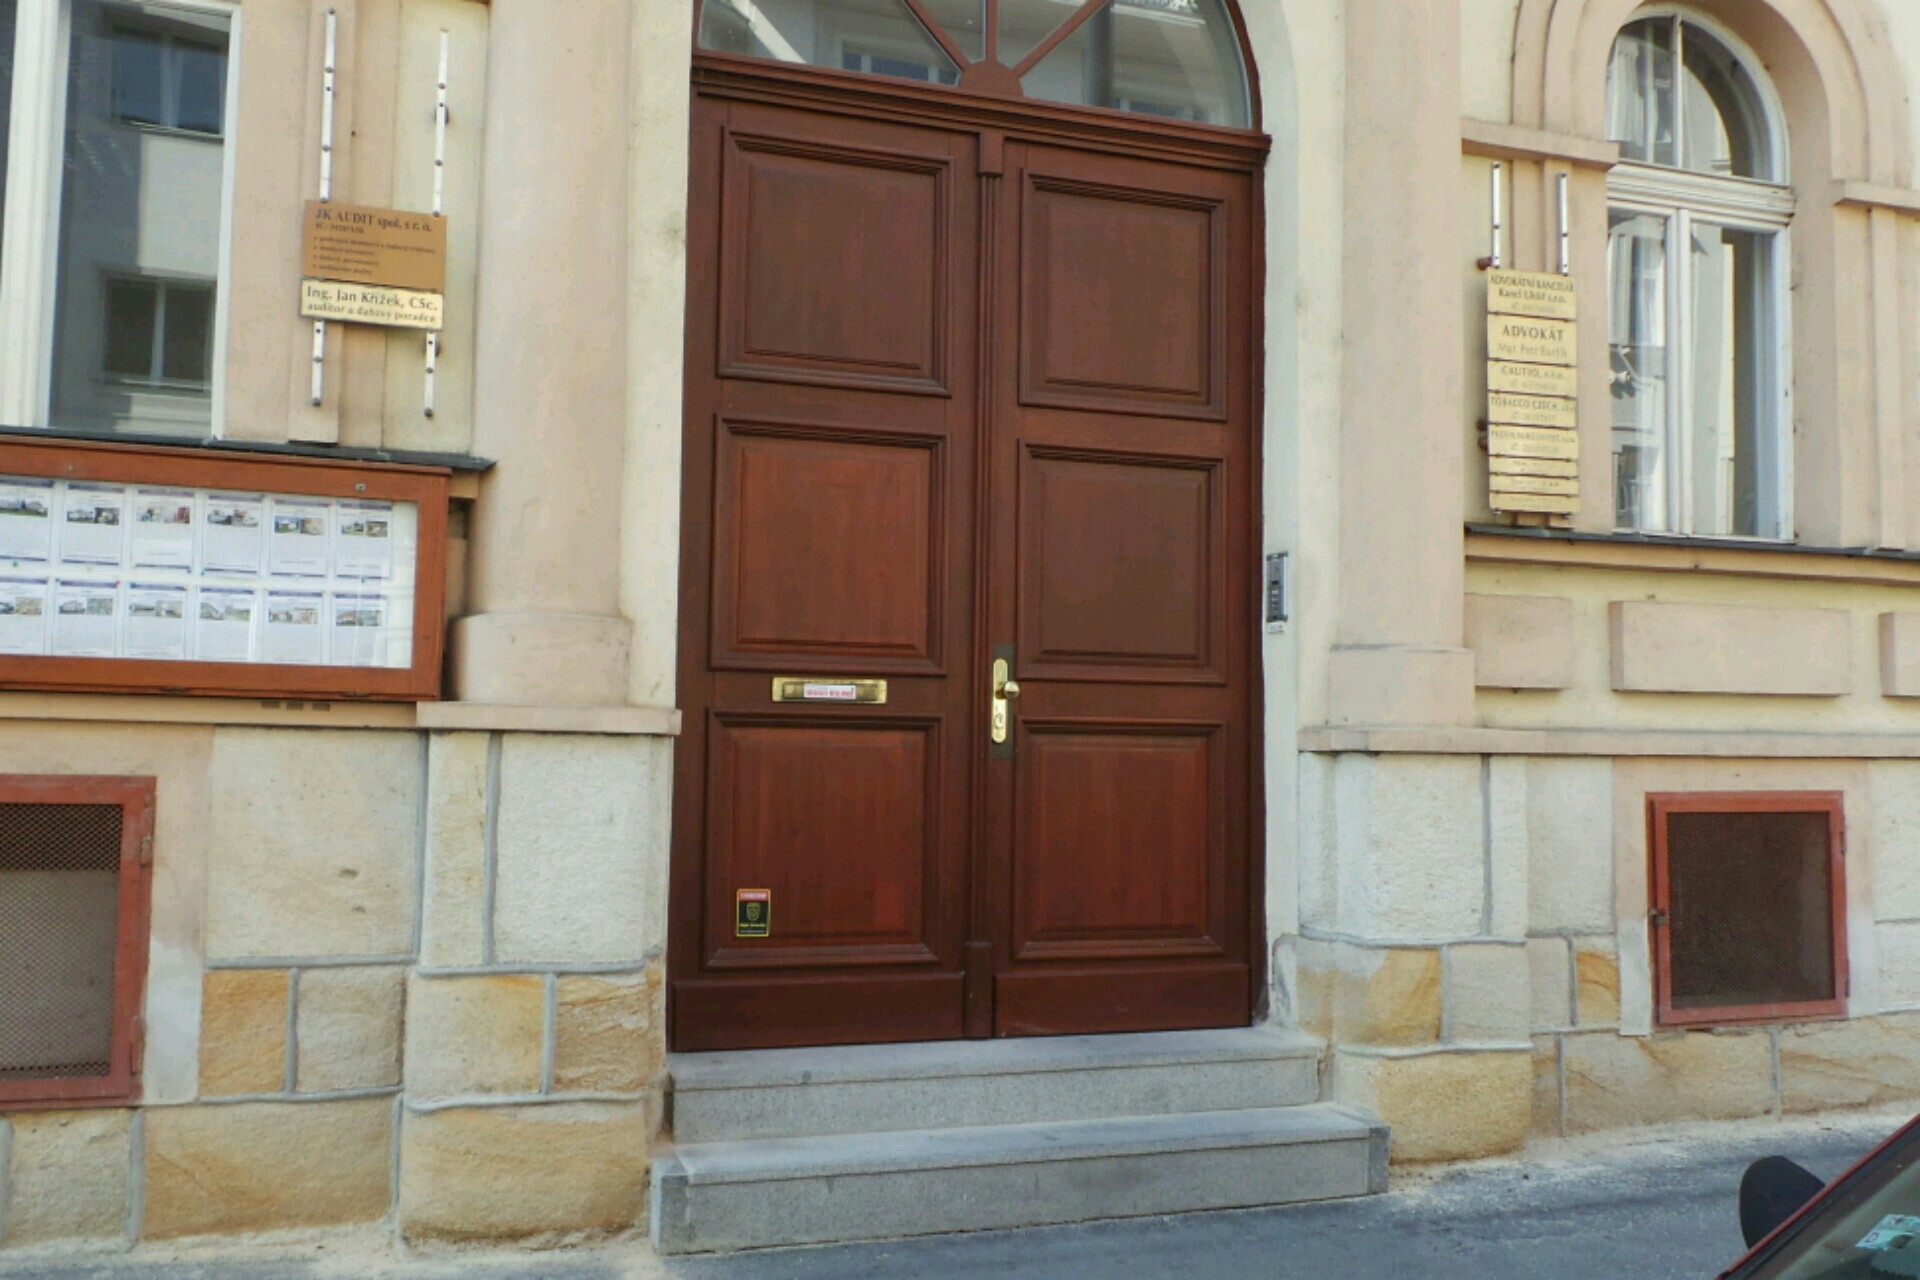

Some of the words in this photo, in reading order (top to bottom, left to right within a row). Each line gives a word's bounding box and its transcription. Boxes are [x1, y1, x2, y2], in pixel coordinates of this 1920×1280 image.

[336, 210, 375, 225] AUDIT
[377, 217, 402, 229] spol.
[307, 286, 332, 300] Ing.
[337, 288, 356, 302] Jan
[408, 297, 438, 311] CSc.
[308, 302, 344, 313] auditor
[1503, 325, 1563, 341] ADVOKÁT
